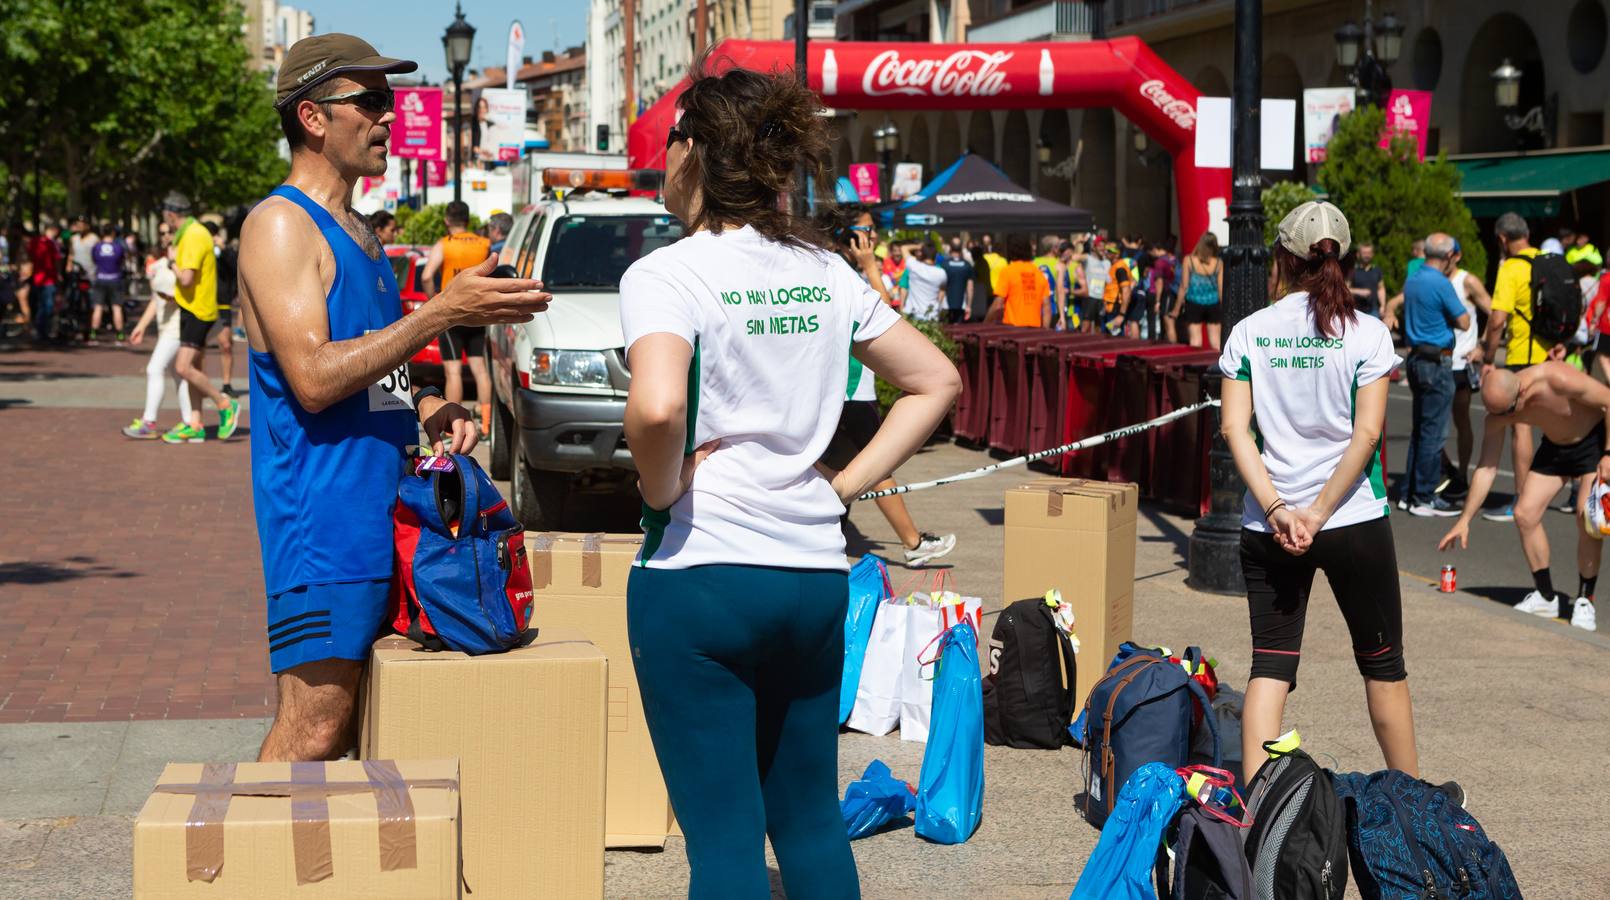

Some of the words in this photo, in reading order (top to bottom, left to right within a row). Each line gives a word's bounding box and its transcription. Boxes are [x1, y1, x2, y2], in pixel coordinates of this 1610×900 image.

[862, 50, 1014, 97] Coca-Cola
[936, 191, 1035, 203] POWERADE
[720, 291, 742, 305] NO
[746, 289, 767, 305] HAY
[769, 286, 831, 305] LOGROS
[746, 319, 765, 335] SIN
[769, 314, 819, 335] METAS
[1256, 336, 1271, 347] NO
[1275, 337, 1293, 348] HAY
[1295, 336, 1343, 349] LOGROS
[1270, 357, 1288, 368] SIN
